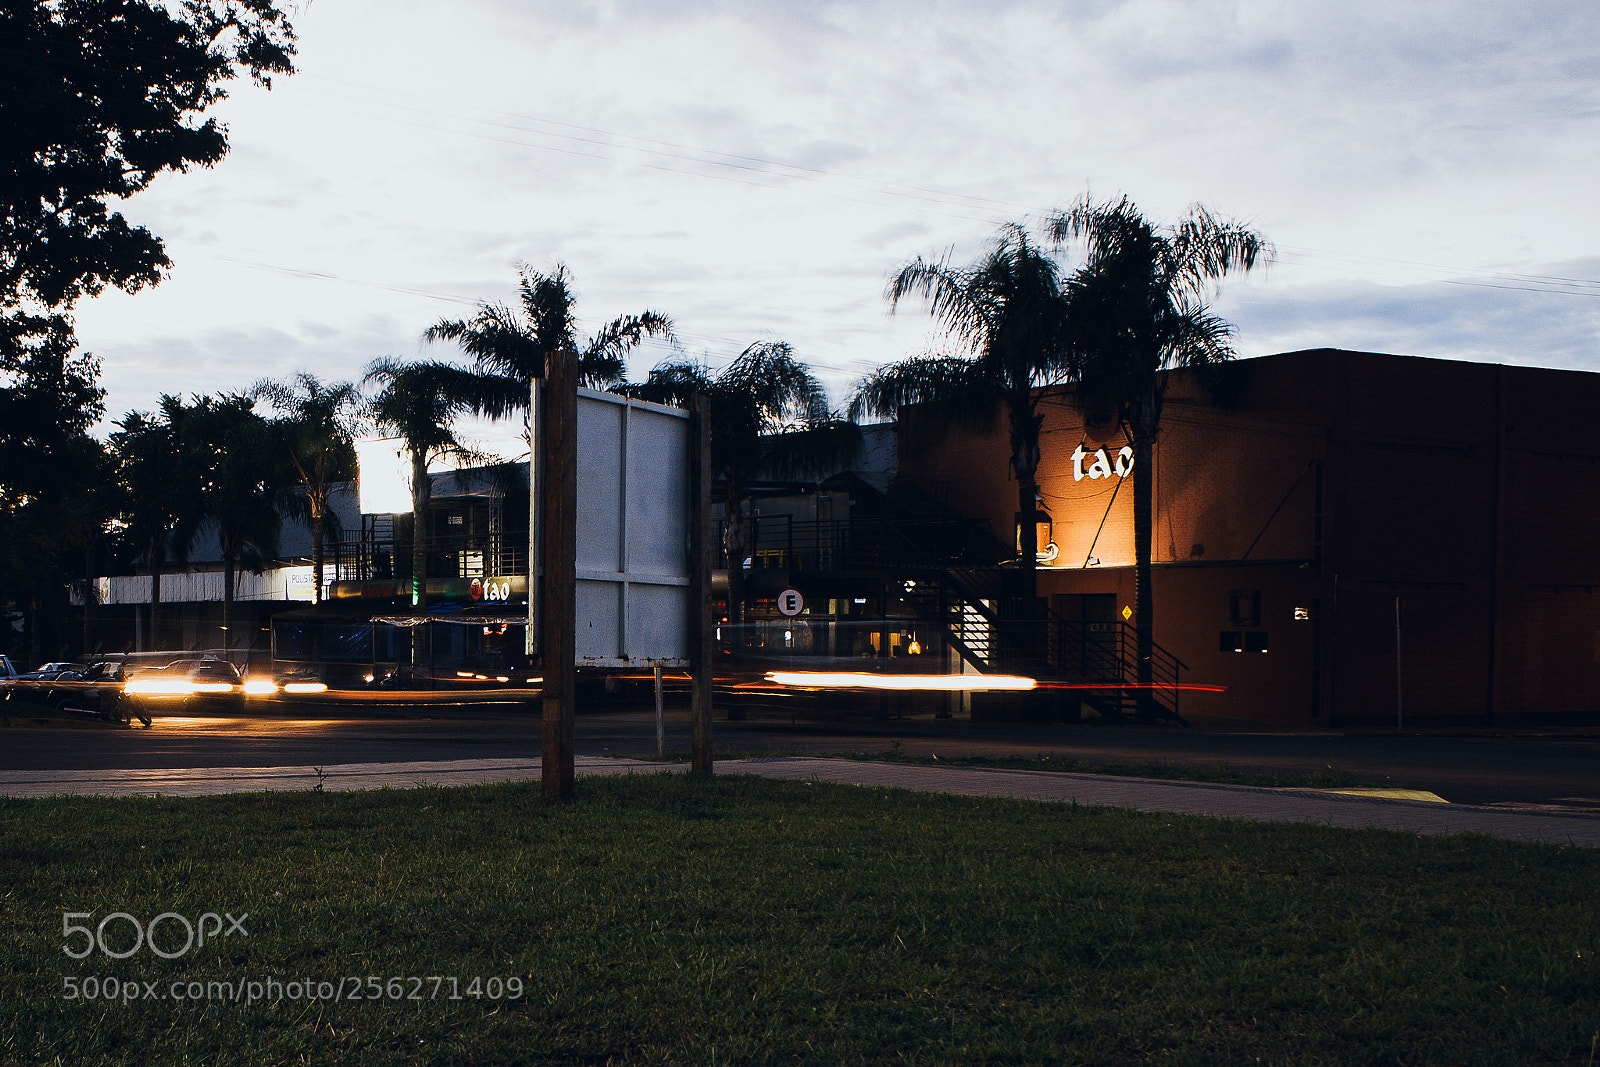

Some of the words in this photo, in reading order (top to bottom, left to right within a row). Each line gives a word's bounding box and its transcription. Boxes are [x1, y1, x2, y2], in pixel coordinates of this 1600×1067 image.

[1070, 444, 1134, 481] tao
[482, 578, 510, 600] tao
[785, 594, 796, 611] E
